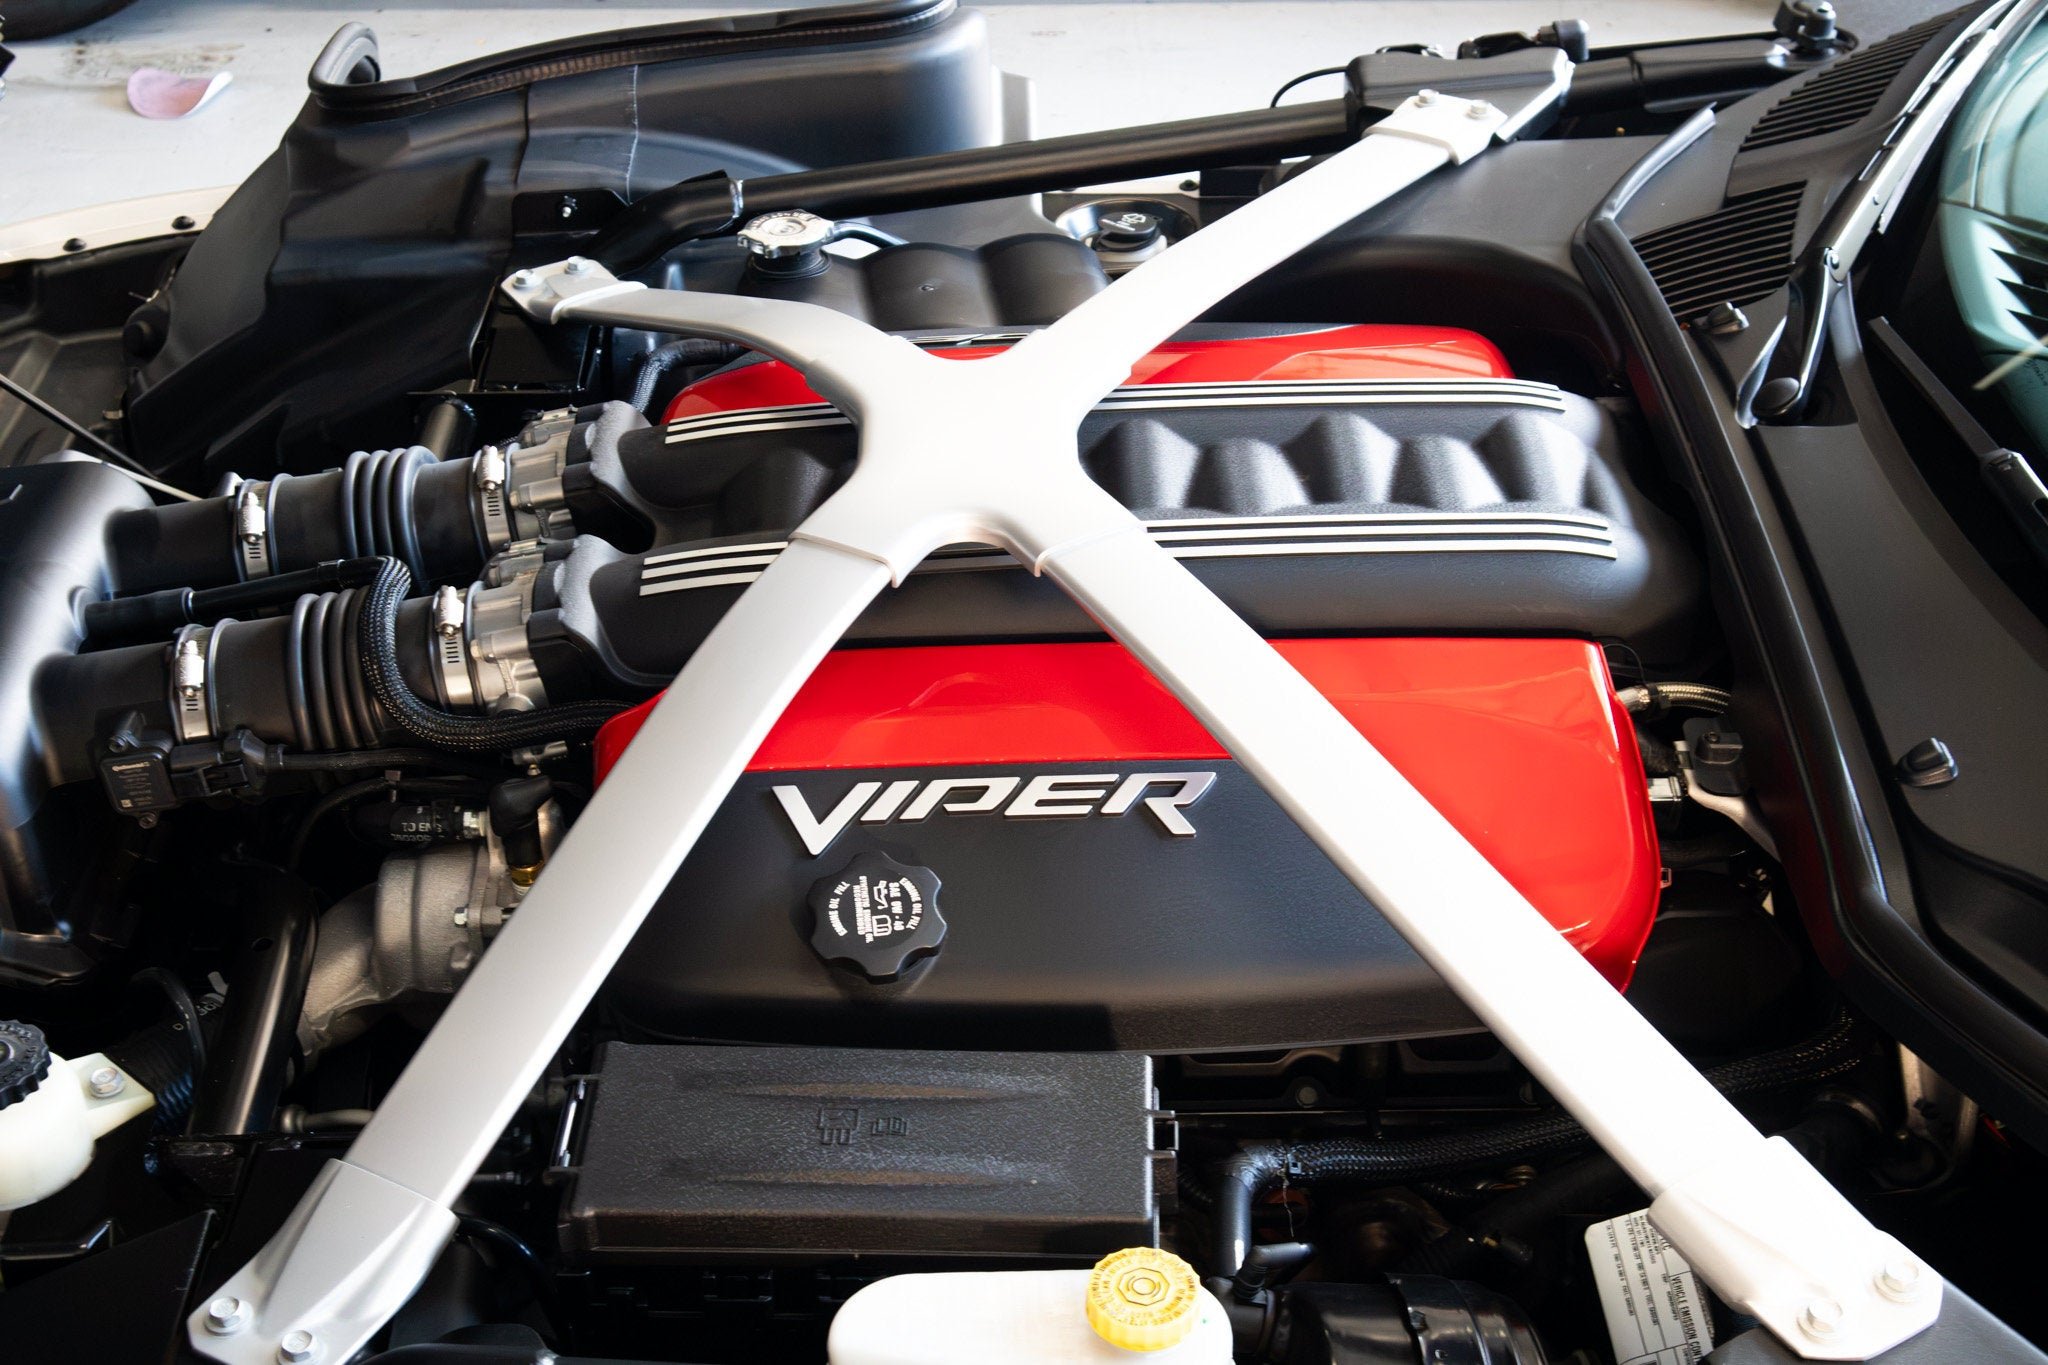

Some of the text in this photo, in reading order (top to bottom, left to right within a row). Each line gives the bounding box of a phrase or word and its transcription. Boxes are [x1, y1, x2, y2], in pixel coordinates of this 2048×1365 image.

[772, 771, 1217, 856] VIPER
[889, 882, 901, 897] SAE
[900, 877, 922, 929] ENGINE OIL FILL
[829, 882, 851, 936] ENGINE OIL FILL
[893, 921, 904, 931] 40
[1670, 1275, 1687, 1304] VEHICLE
[1678, 1305, 1697, 1340] EMISSION
